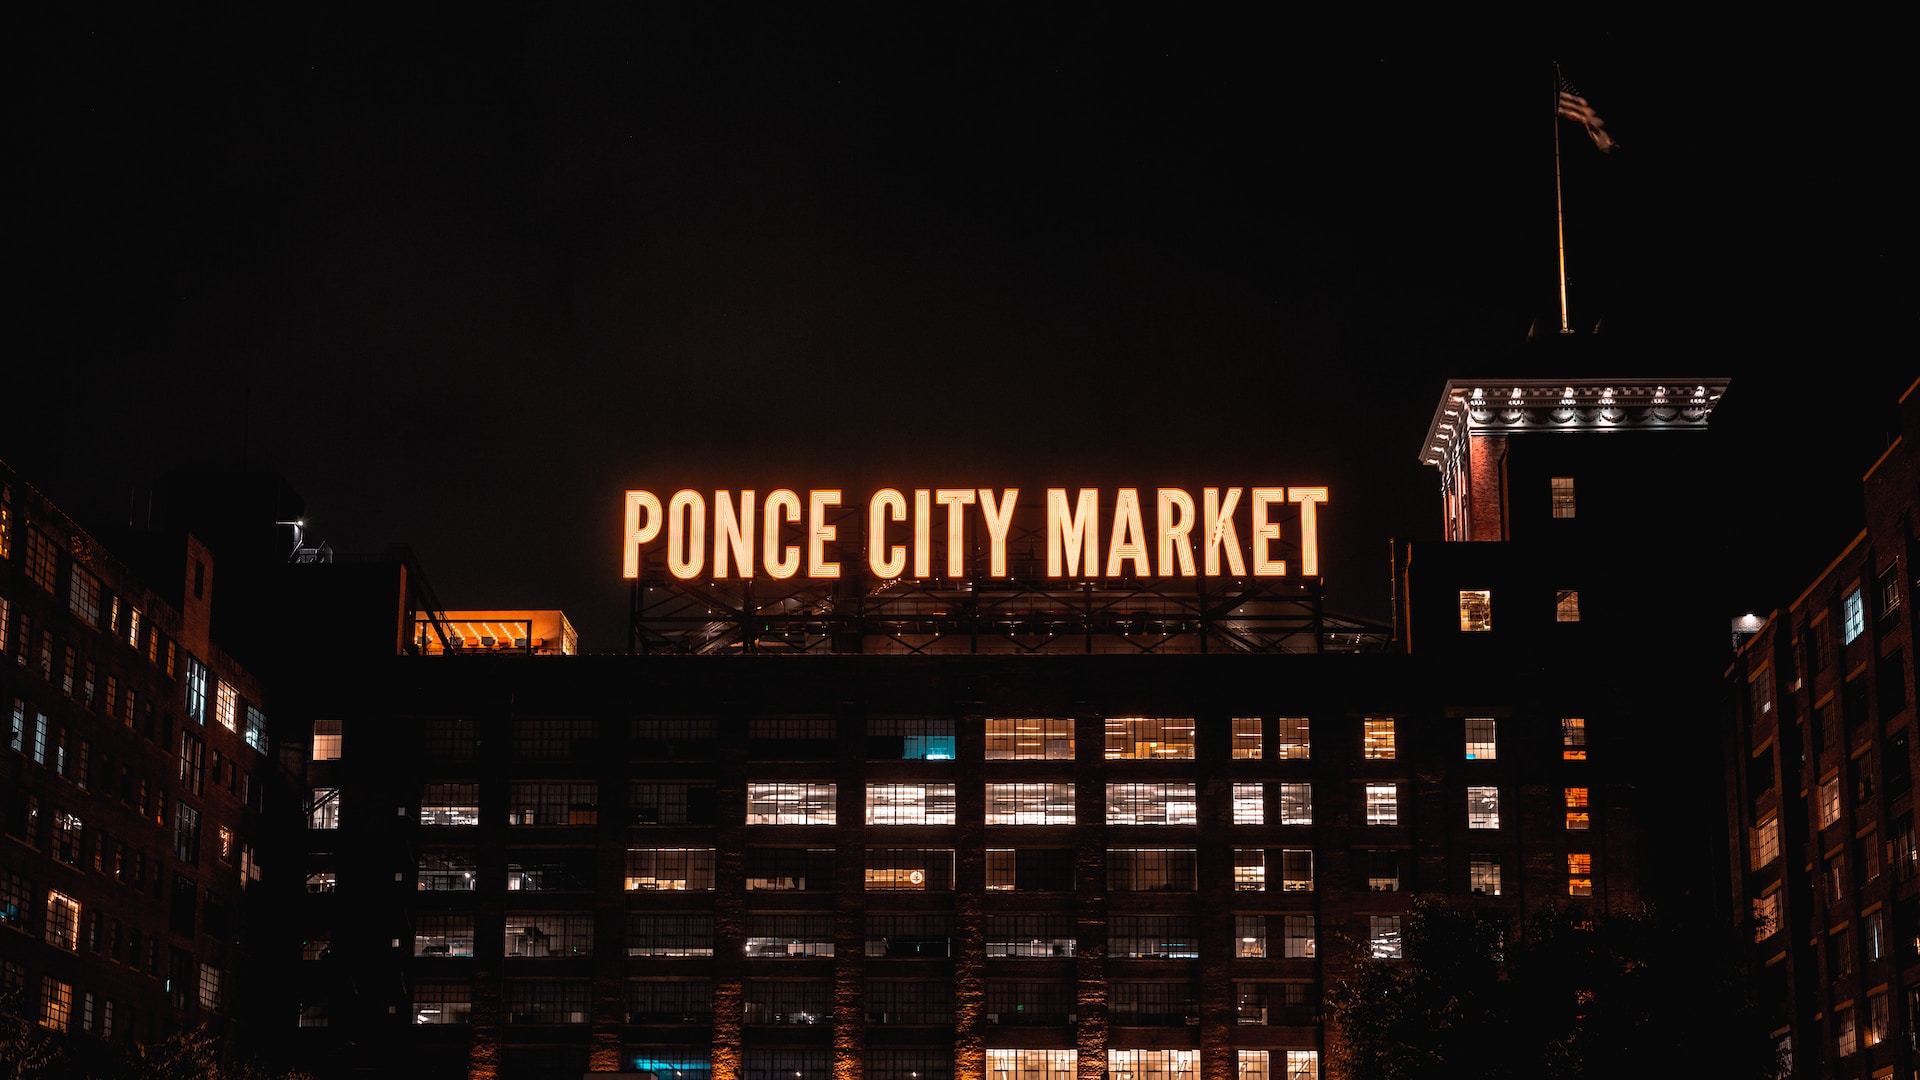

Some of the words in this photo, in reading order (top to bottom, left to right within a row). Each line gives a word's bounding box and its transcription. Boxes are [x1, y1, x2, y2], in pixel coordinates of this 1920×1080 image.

[622, 489, 843, 579] PONCE
[868, 488, 1020, 578] CITY
[1045, 486, 1330, 578] MARKET
